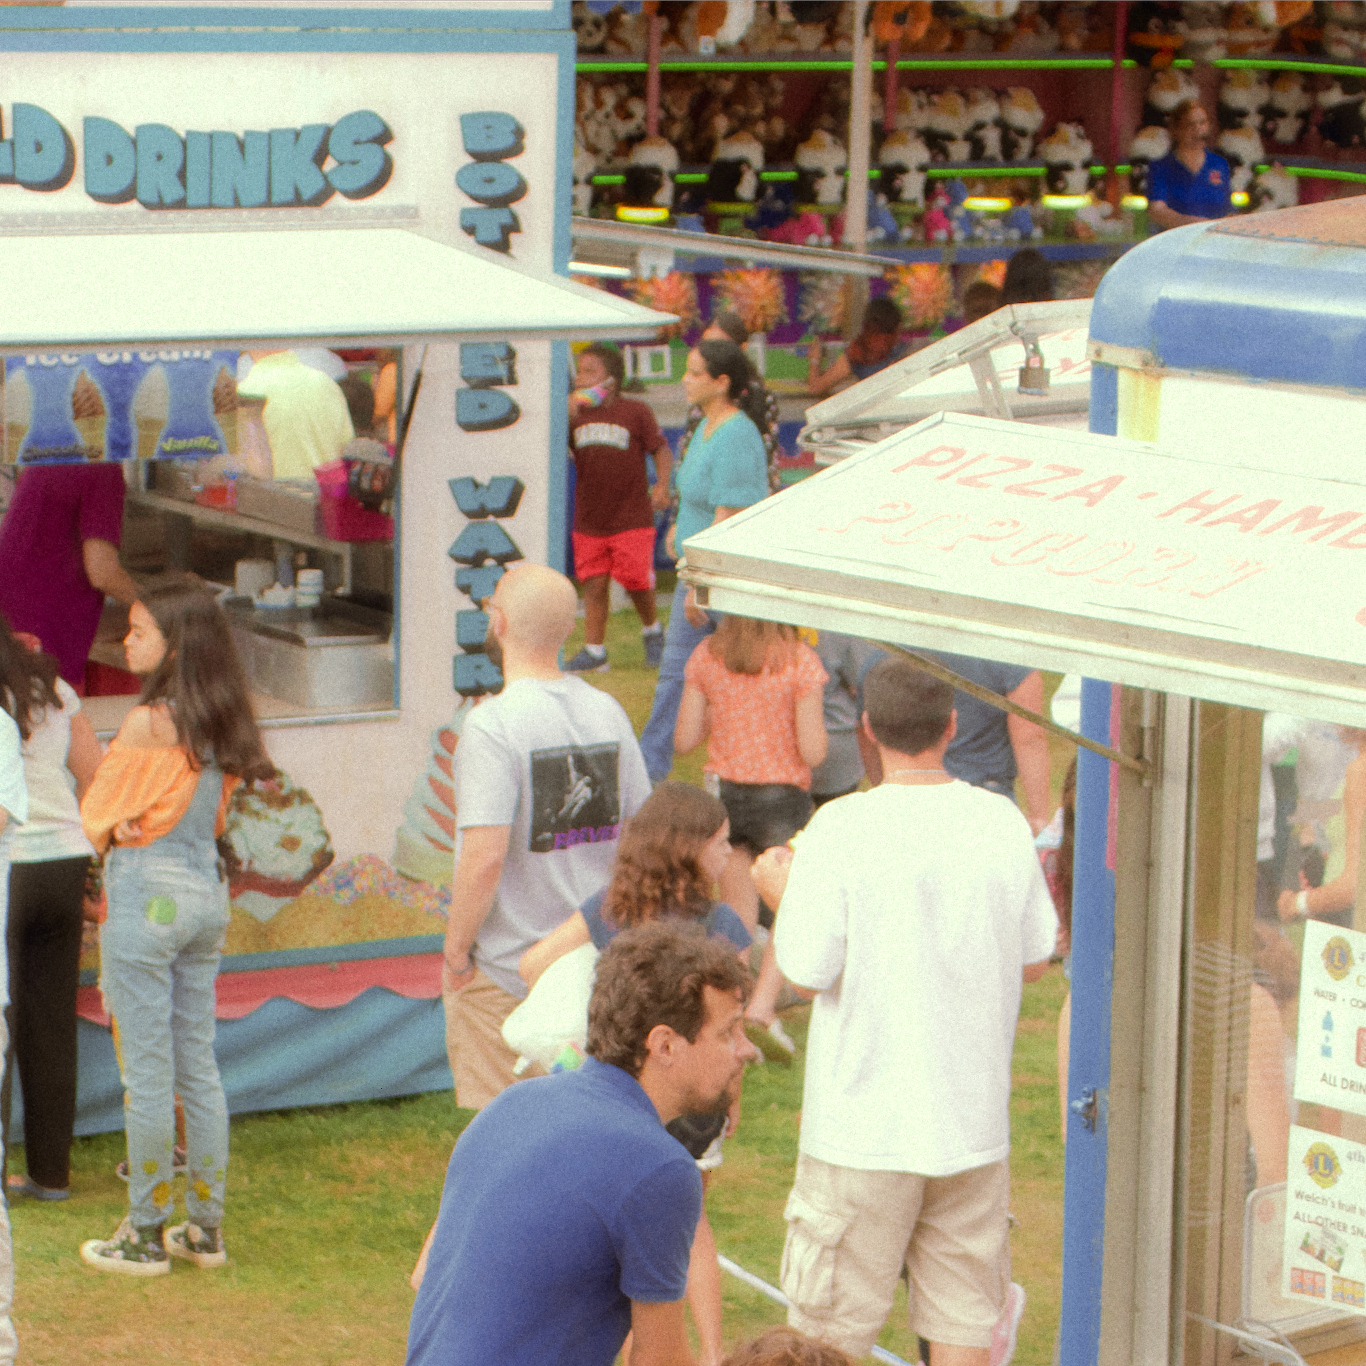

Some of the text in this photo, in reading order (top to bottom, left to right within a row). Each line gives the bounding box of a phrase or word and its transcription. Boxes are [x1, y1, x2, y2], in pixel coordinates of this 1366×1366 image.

[83, 109, 393, 210] DRINKS
[447, 111, 527, 696] BOTED WATER
[893, 445, 1128, 508] PIZZA
[1320, 1071, 1338, 1088] ALL
[1346, 1150, 1366, 1164] 4th
[1294, 1189, 1337, 1209] Welch's
[1292, 1210, 1311, 1223] ALL
[1314, 1215, 1349, 1233] OTHER
